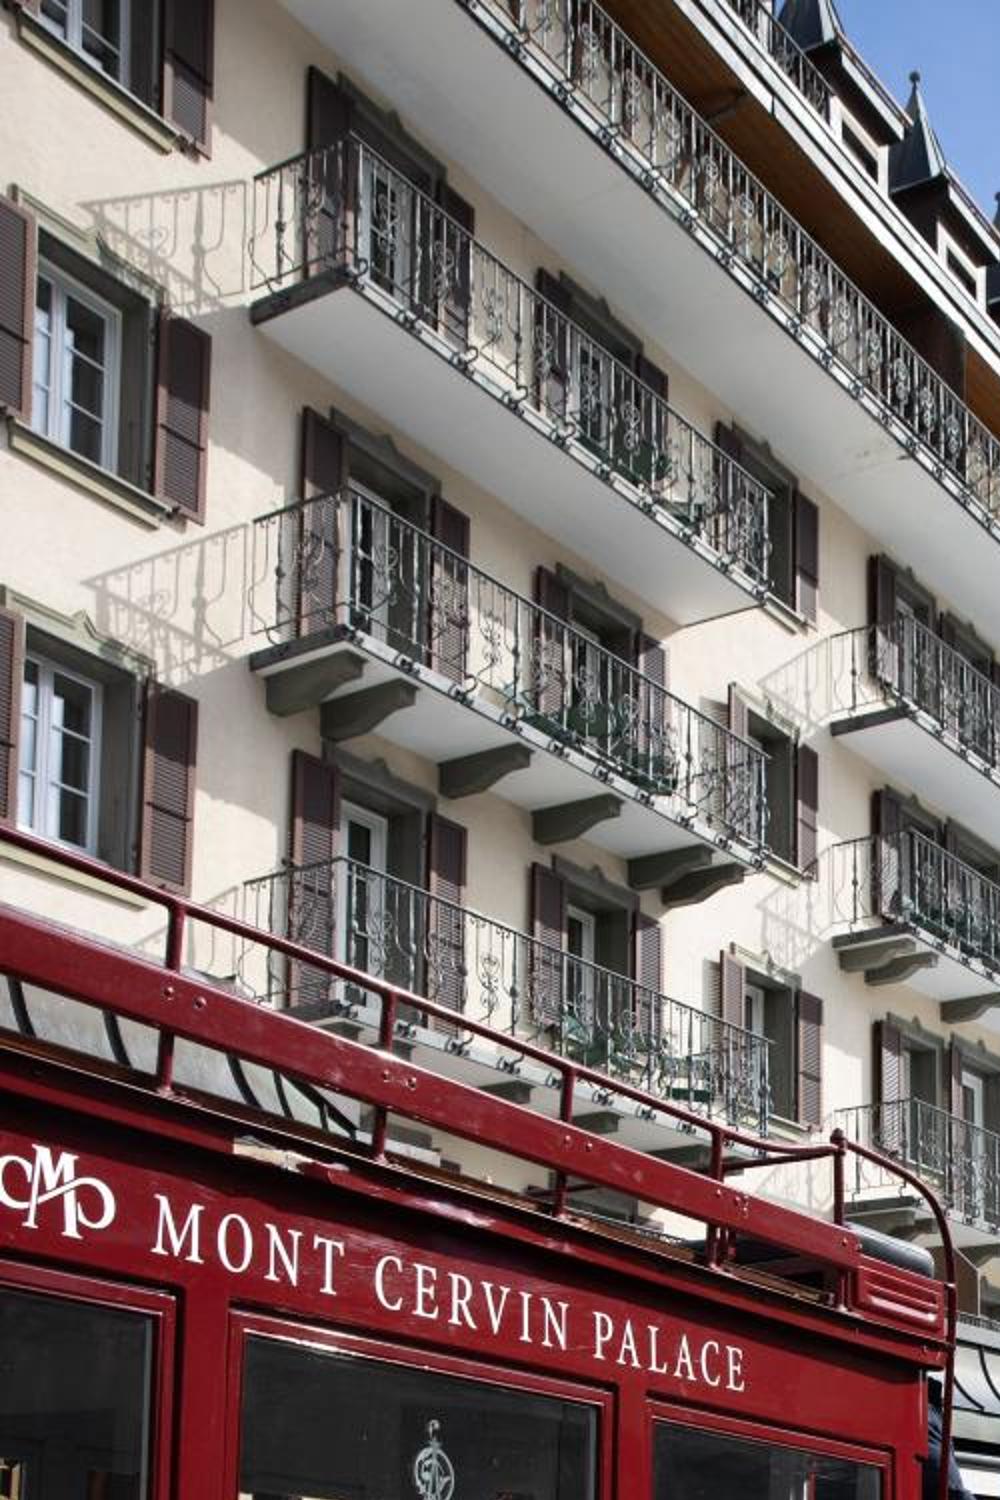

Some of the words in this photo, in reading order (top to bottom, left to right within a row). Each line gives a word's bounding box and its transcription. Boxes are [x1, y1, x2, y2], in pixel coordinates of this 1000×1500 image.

[150, 1193, 345, 1296] MONT
[374, 1254, 570, 1351] CERVIN
[592, 1310, 746, 1393] PALACE
